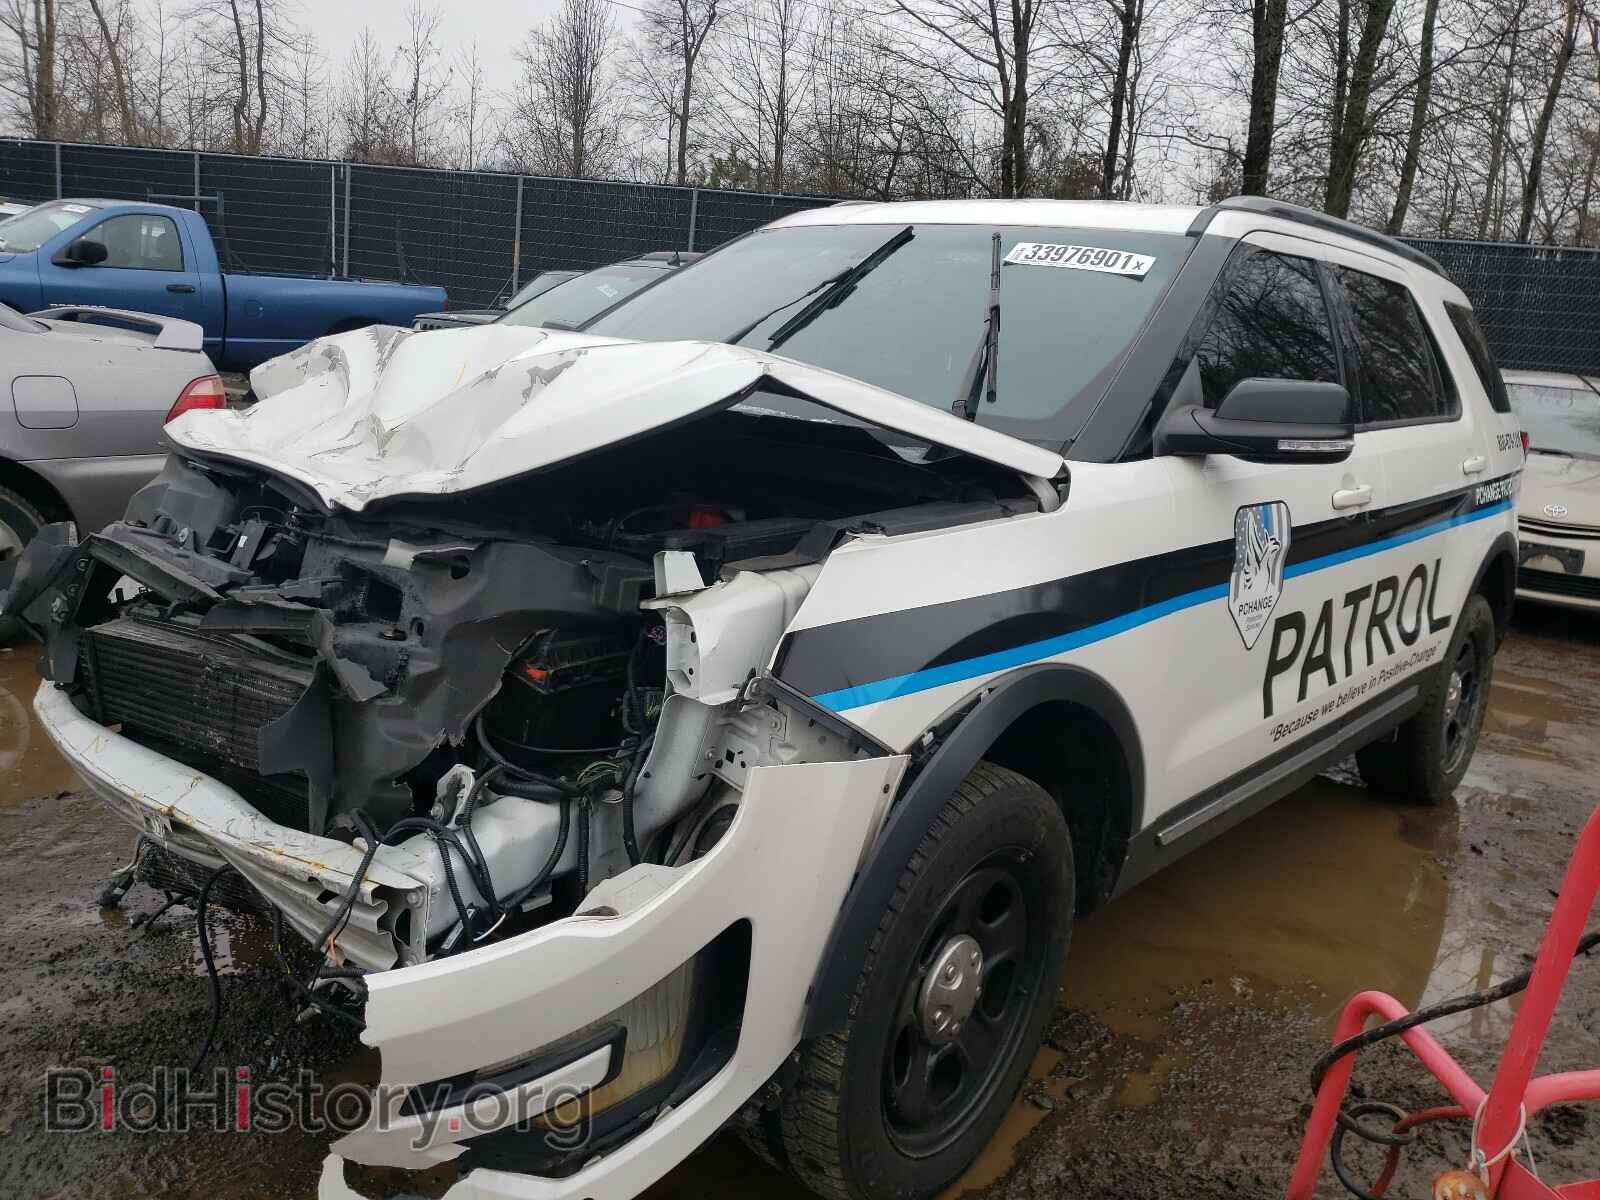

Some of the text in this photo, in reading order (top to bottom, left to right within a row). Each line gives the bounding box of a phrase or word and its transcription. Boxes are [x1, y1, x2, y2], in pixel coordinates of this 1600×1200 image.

[1024, 244, 1133, 270] 33976901
[1238, 595, 1273, 617] PCHANGE
[1262, 557, 1452, 720] PATROL
[1321, 699, 1336, 715] we
[1336, 685, 1368, 708] believe
[1368, 674, 1377, 690] in
